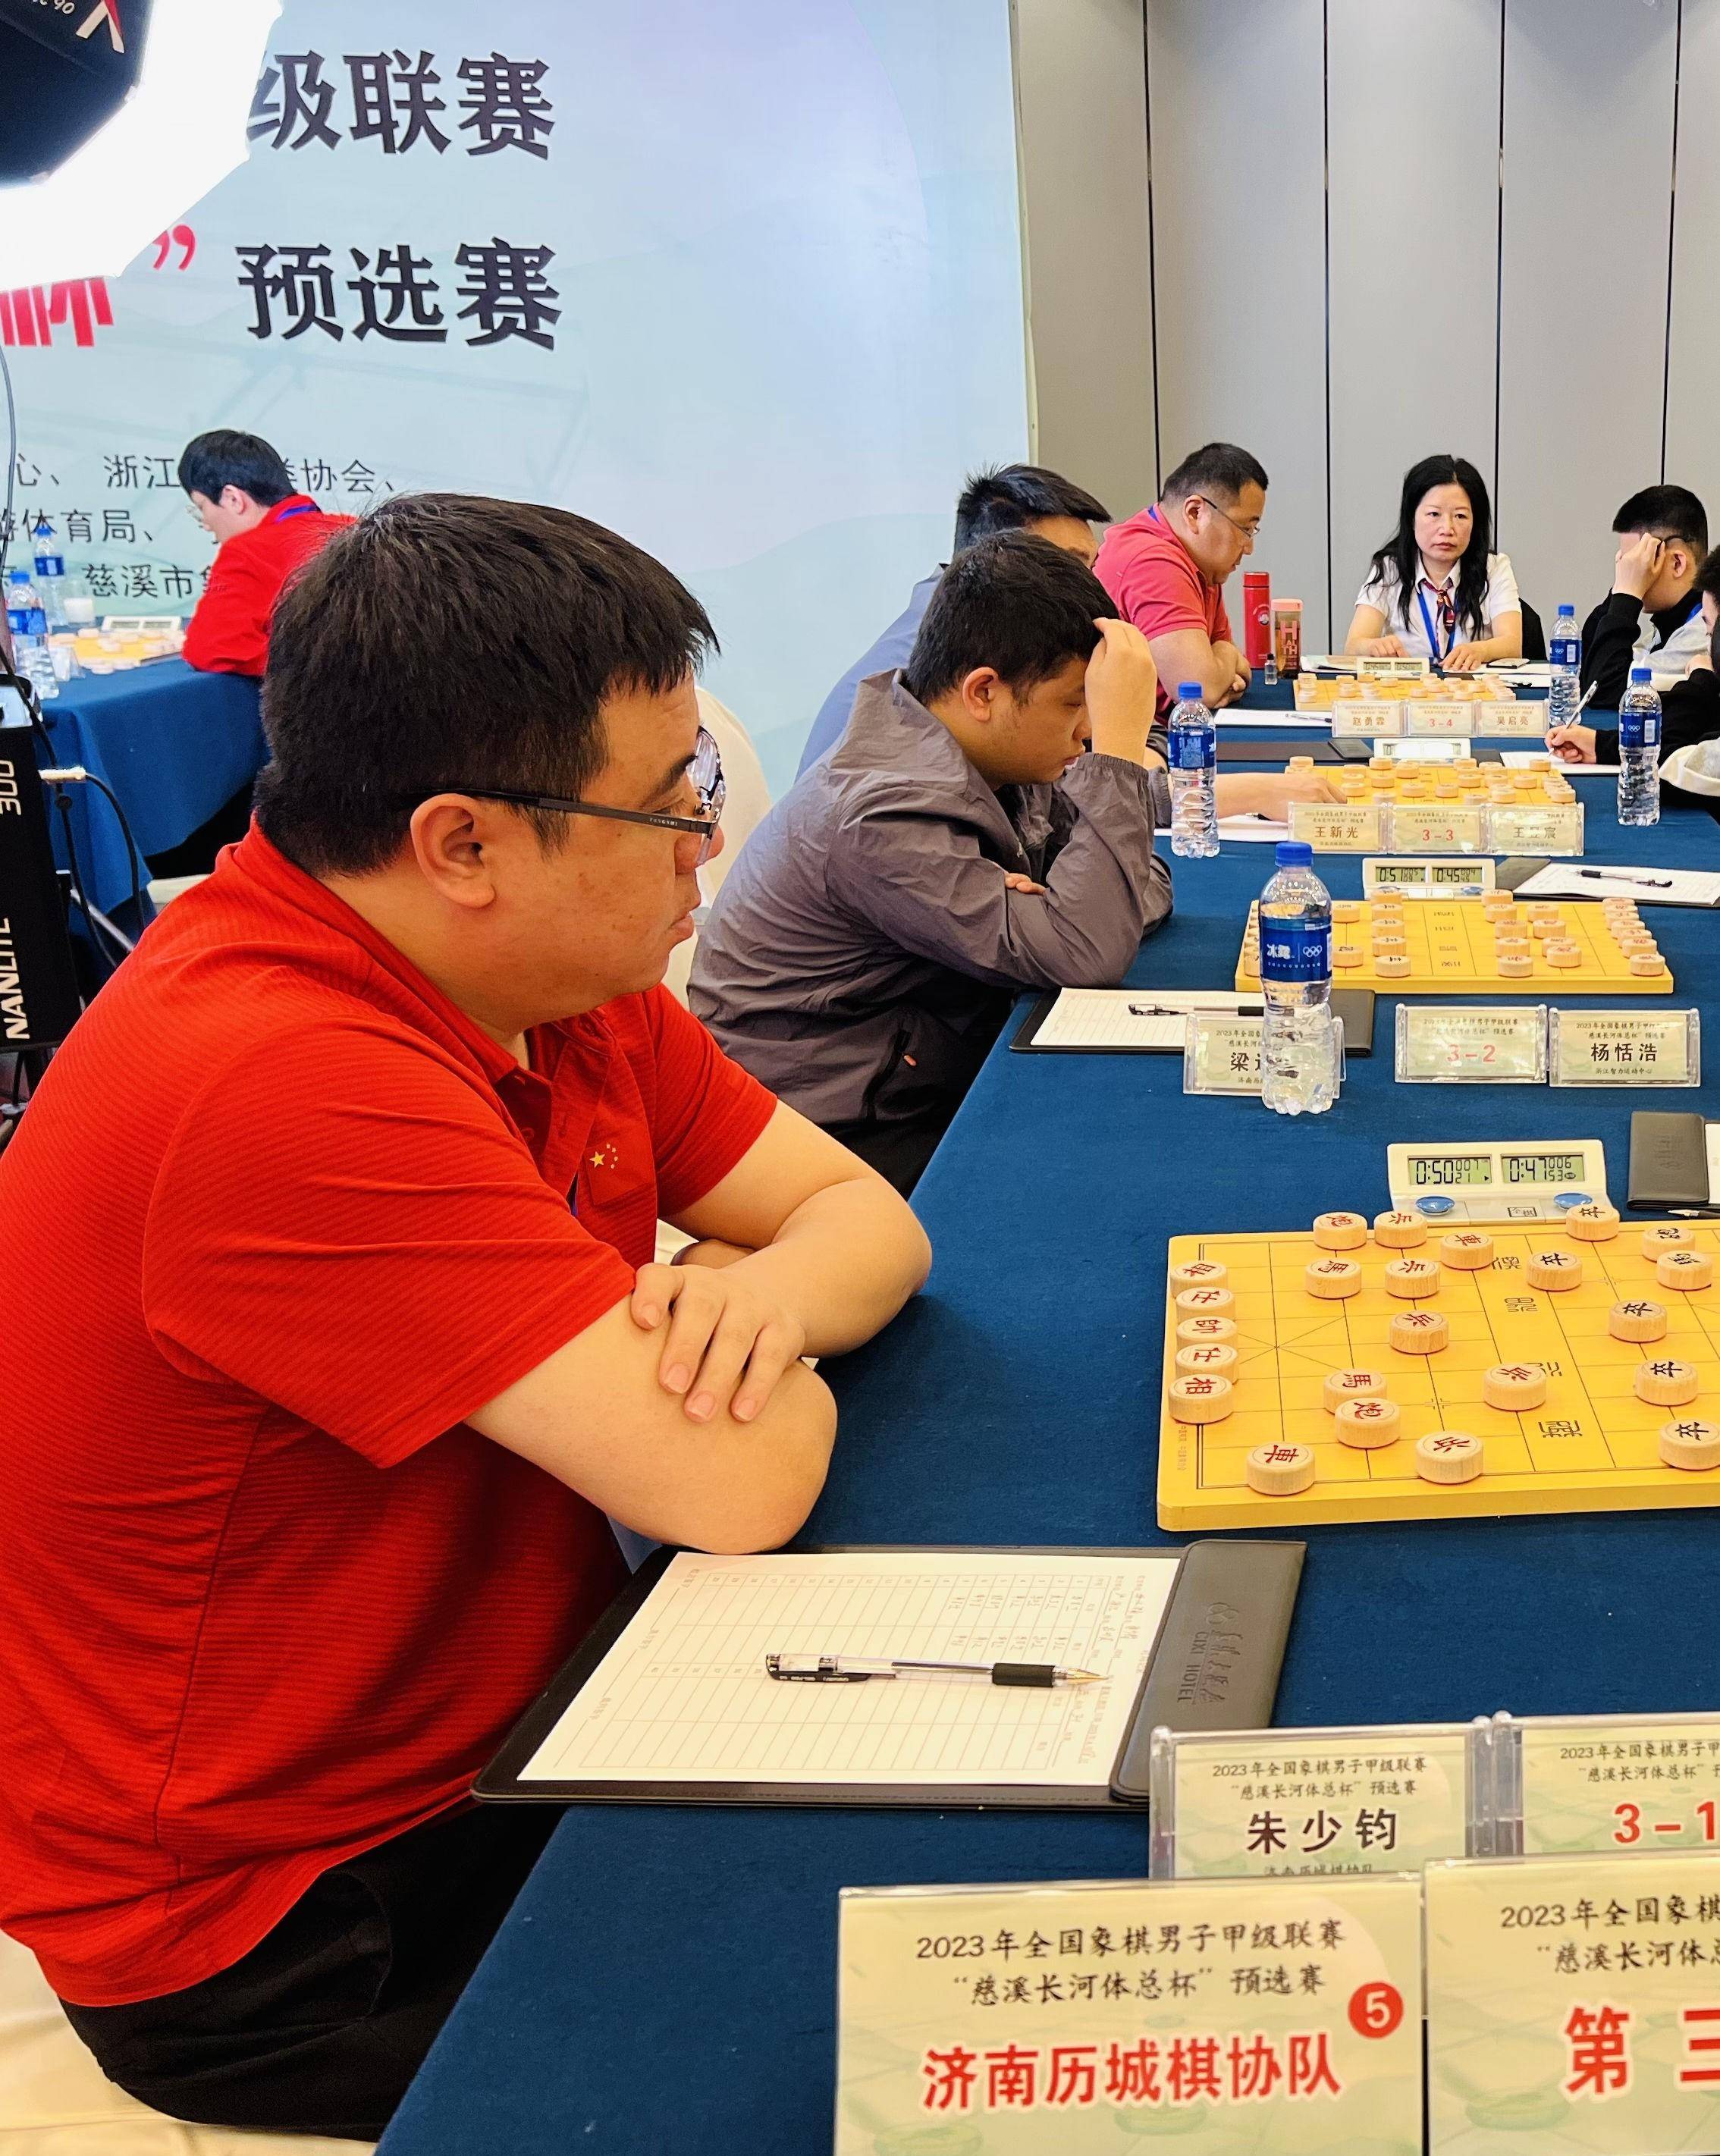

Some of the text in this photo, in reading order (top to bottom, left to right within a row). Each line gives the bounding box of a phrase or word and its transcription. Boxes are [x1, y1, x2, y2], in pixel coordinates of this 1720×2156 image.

[246, 49, 556, 160] 级联赛
[235, 236, 563, 351] 预选赛
[83, 563, 214, 599] 慈溪市
[1314, 826, 1358, 839] 王新光
[1422, 829, 1454, 841] 3-3
[1446, 1043, 1496, 1063] 3-2
[1590, 1042, 1658, 1062] 杨恬浩
[1416, 1160, 1454, 1185] 0:50
[1509, 1158, 1547, 1182] 0:47
[1213, 1756, 1427, 1778] 2023年全国象棋男子甲级联赛
[1370, 1780, 1417, 1797] 预选赛
[1247, 1808, 1397, 1855] 朱少钧
[1614, 1801, 1715, 1844] 3-1
[915, 1918, 1347, 1963] 2023年全国象棋男子甲级联赛
[1230, 1964, 1329, 1997] 预选赛
[1364, 1990, 1391, 2029] 5
[1565, 2006, 1720, 2095] 第三
[922, 2032, 1342, 2110] 济南历城棋协队
